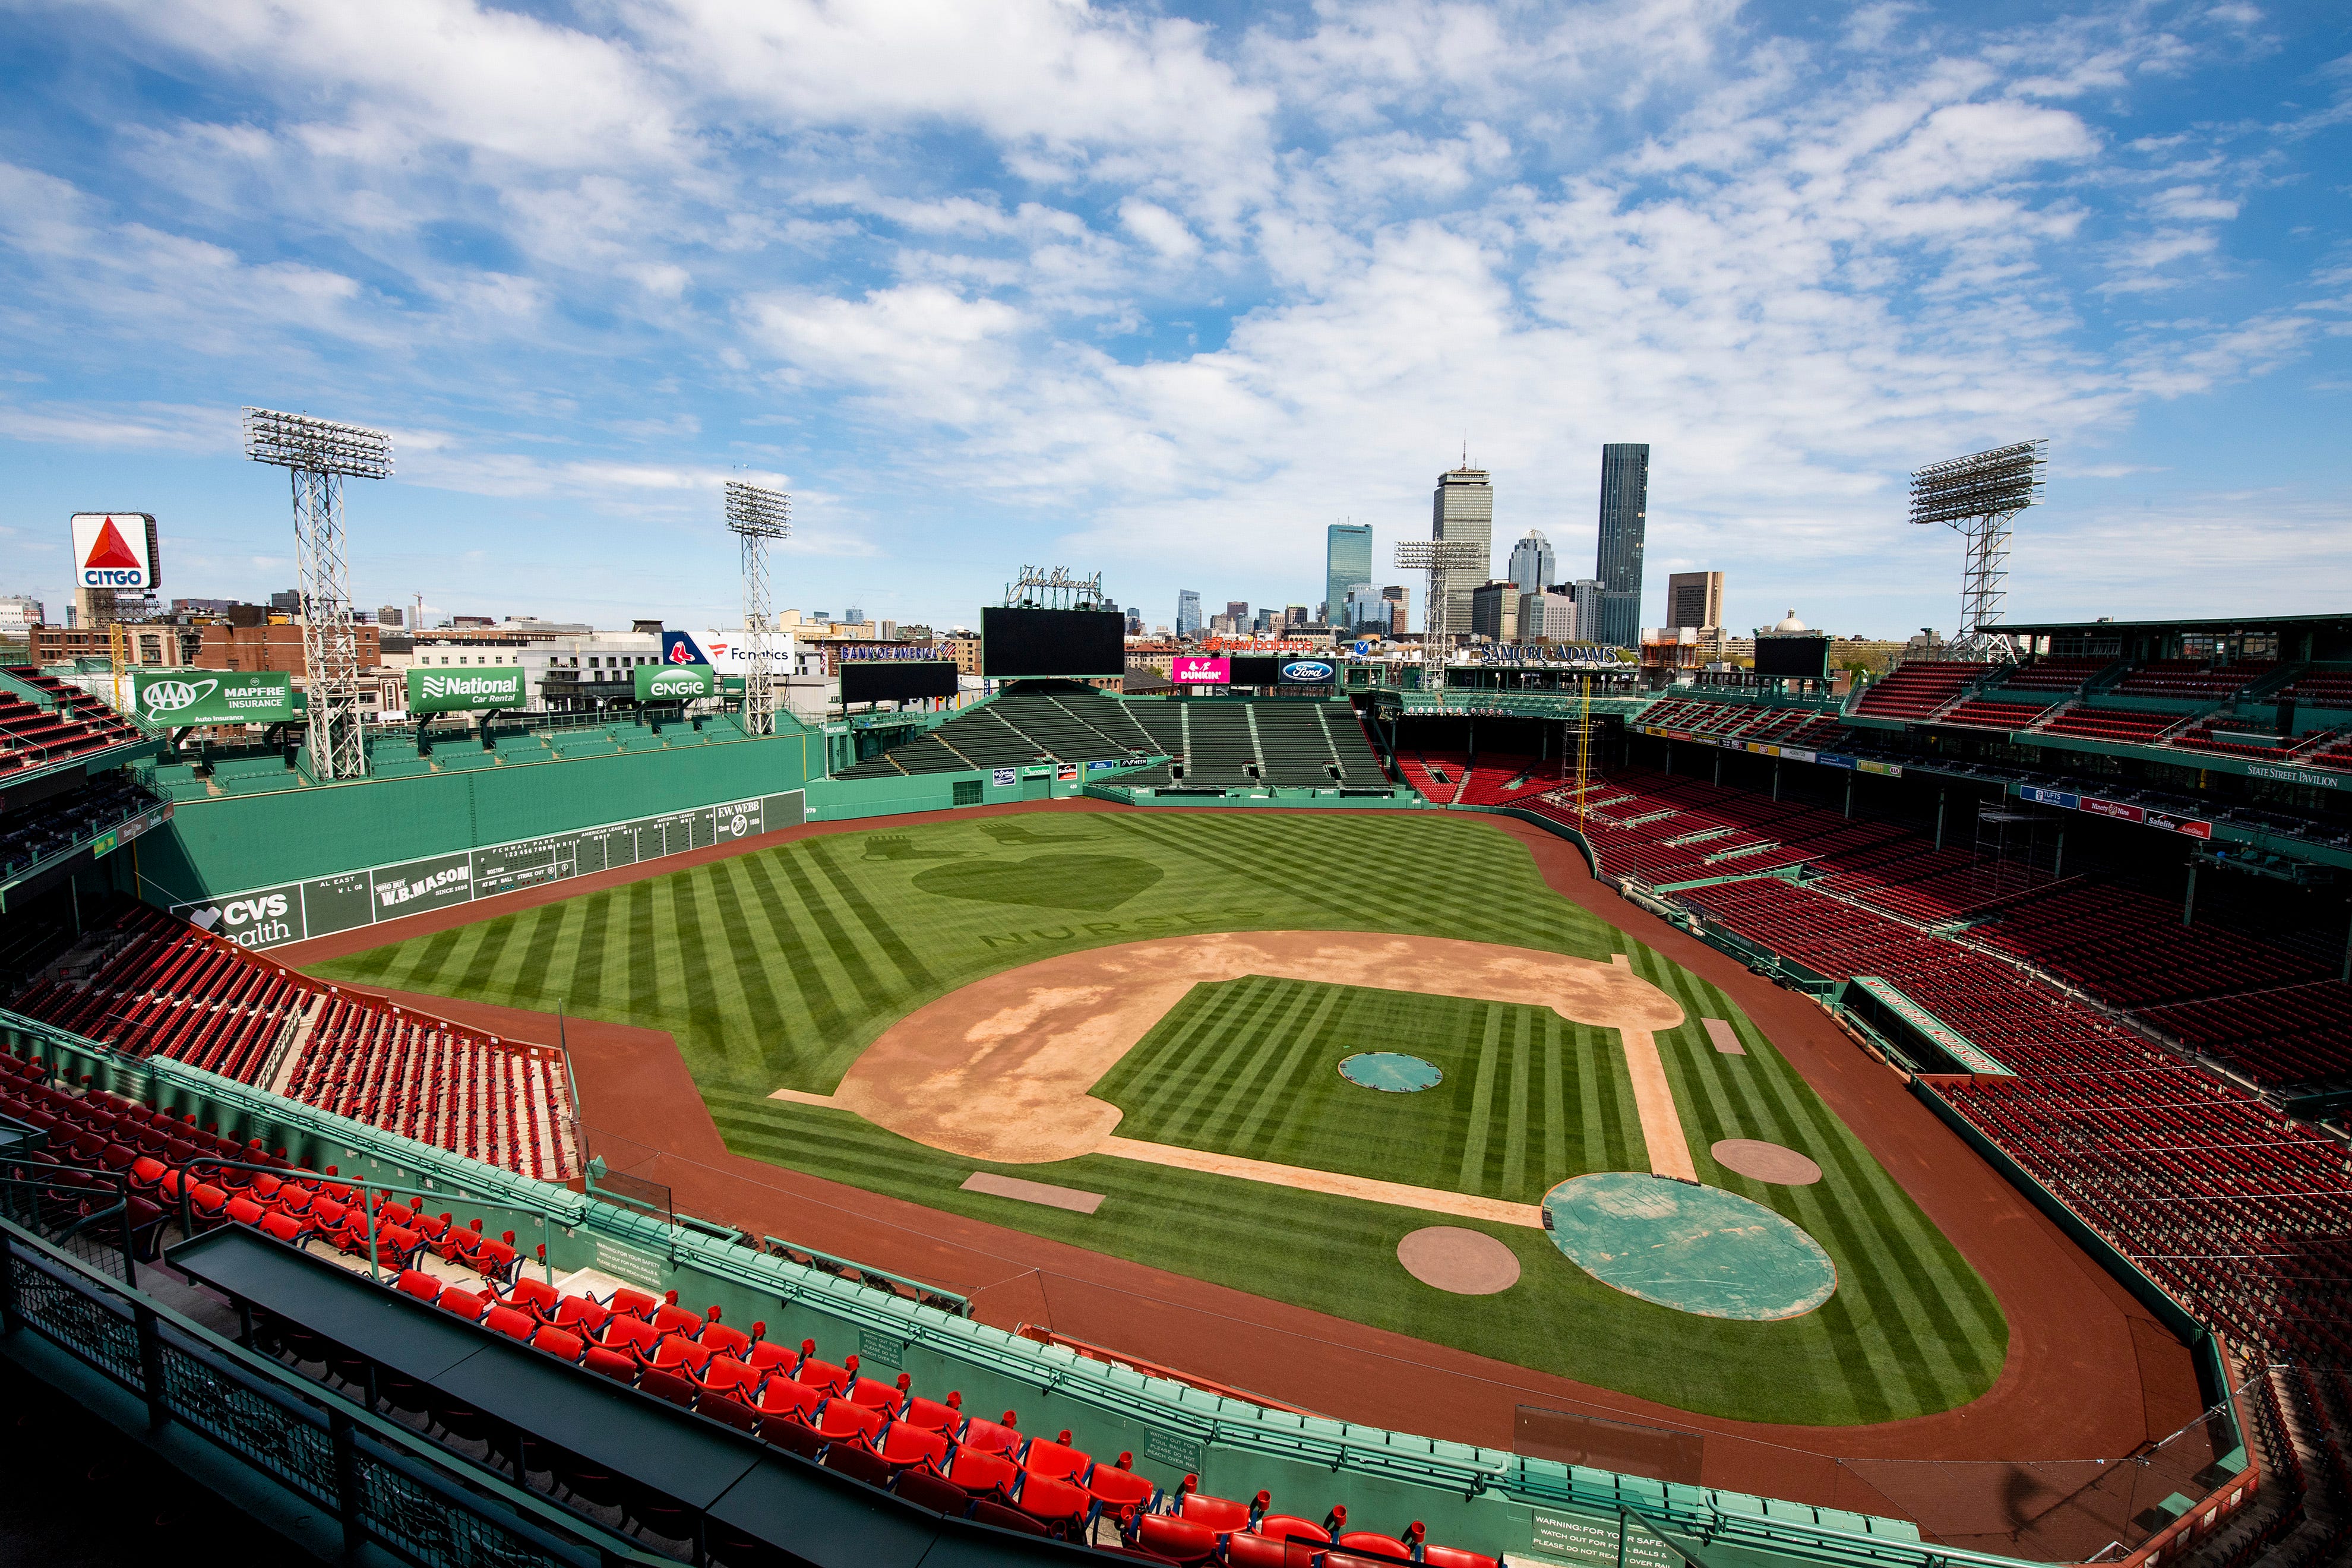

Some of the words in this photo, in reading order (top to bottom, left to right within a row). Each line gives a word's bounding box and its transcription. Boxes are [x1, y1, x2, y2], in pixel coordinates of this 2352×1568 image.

[86, 570, 141, 585] CITGO
[1007, 564, 1048, 603] John
[1048, 565, 1104, 600] Hancock
[1224, 640, 1253, 650] new
[1254, 637, 1313, 651] balance
[840, 647, 874, 659] BANK
[876, 647, 890, 659] OF
[893, 647, 938, 659] AMERICA
[1481, 644, 1547, 663] SAMUEL
[1555, 643, 1617, 663] ADAMS
[1181, 671, 1222, 679] DUNKIN'
[1292, 663, 1322, 678] Ford
[225, 687, 285, 697] MAPFRE
[445, 676, 517, 695] National
[229, 699, 282, 709] INSURANCE
[489, 694, 516, 702] Rental
[2247, 764, 2269, 776] STATE
[2269, 768, 2297, 781] STREET
[2299, 772, 2338, 788] PAVILION
[2044, 791, 2061, 800] TUFTS
[735, 801, 760, 814] WEBB
[2092, 802, 2108, 813] Ninety
[2117, 808, 2129, 816] Nine
[2148, 817, 2175, 829] Safelite
[581, 829, 606, 837] AMERICAN
[2182, 826, 2204, 836] AutoGlass
[492, 843, 527, 854] FENWAY
[487, 867, 504, 875] BOSTON
[334, 876, 355, 884] EAST
[375, 883, 391, 893] WHO
[393, 880, 406, 889] BUT
[435, 887, 454, 896] SINCE
[454, 884, 468, 892] 1898
[224, 893, 288, 925] CVS
[215, 919, 290, 947] ealth
[978, 907, 1264, 948] NURSES
[1870, 988, 1910, 1007] SOX
[1896, 1007, 1937, 1027] RED
[1924, 1029, 2000, 1073] BOSTON
[596, 1257, 611, 1267] PLEASE
[626, 1269, 640, 1277] REACH
[628, 1254, 641, 1263] YOUR
[642, 1259, 660, 1269] SAFETY
[862, 1349, 877, 1357] REACH
[864, 1344, 880, 1353] PLEASE
[878, 1343, 892, 1352] BALLS
[1150, 1431, 1168, 1440] WATCH
[1150, 1443, 1171, 1455] PLEASE
[1152, 1439, 1167, 1447] FOUL
[1169, 1444, 1187, 1453] BALLS
[1147, 1449, 1166, 1459] REACH
[1535, 1515, 1582, 1531] WARNING:
[1583, 1526, 1604, 1536] FOR
[1606, 1531, 1635, 1542] YOR
[1541, 1528, 1567, 1538] WATCH
[1570, 1535, 1587, 1544] OUT
[1589, 1538, 1606, 1547] FOR
[1608, 1543, 1630, 1553] FOL
[1633, 1548, 1659, 1557] BALLS
[1533, 1538, 1564, 1550] PLEASE
[1580, 1547, 1597, 1556] NOT
[1629, 1558, 1652, 1567] OVER
